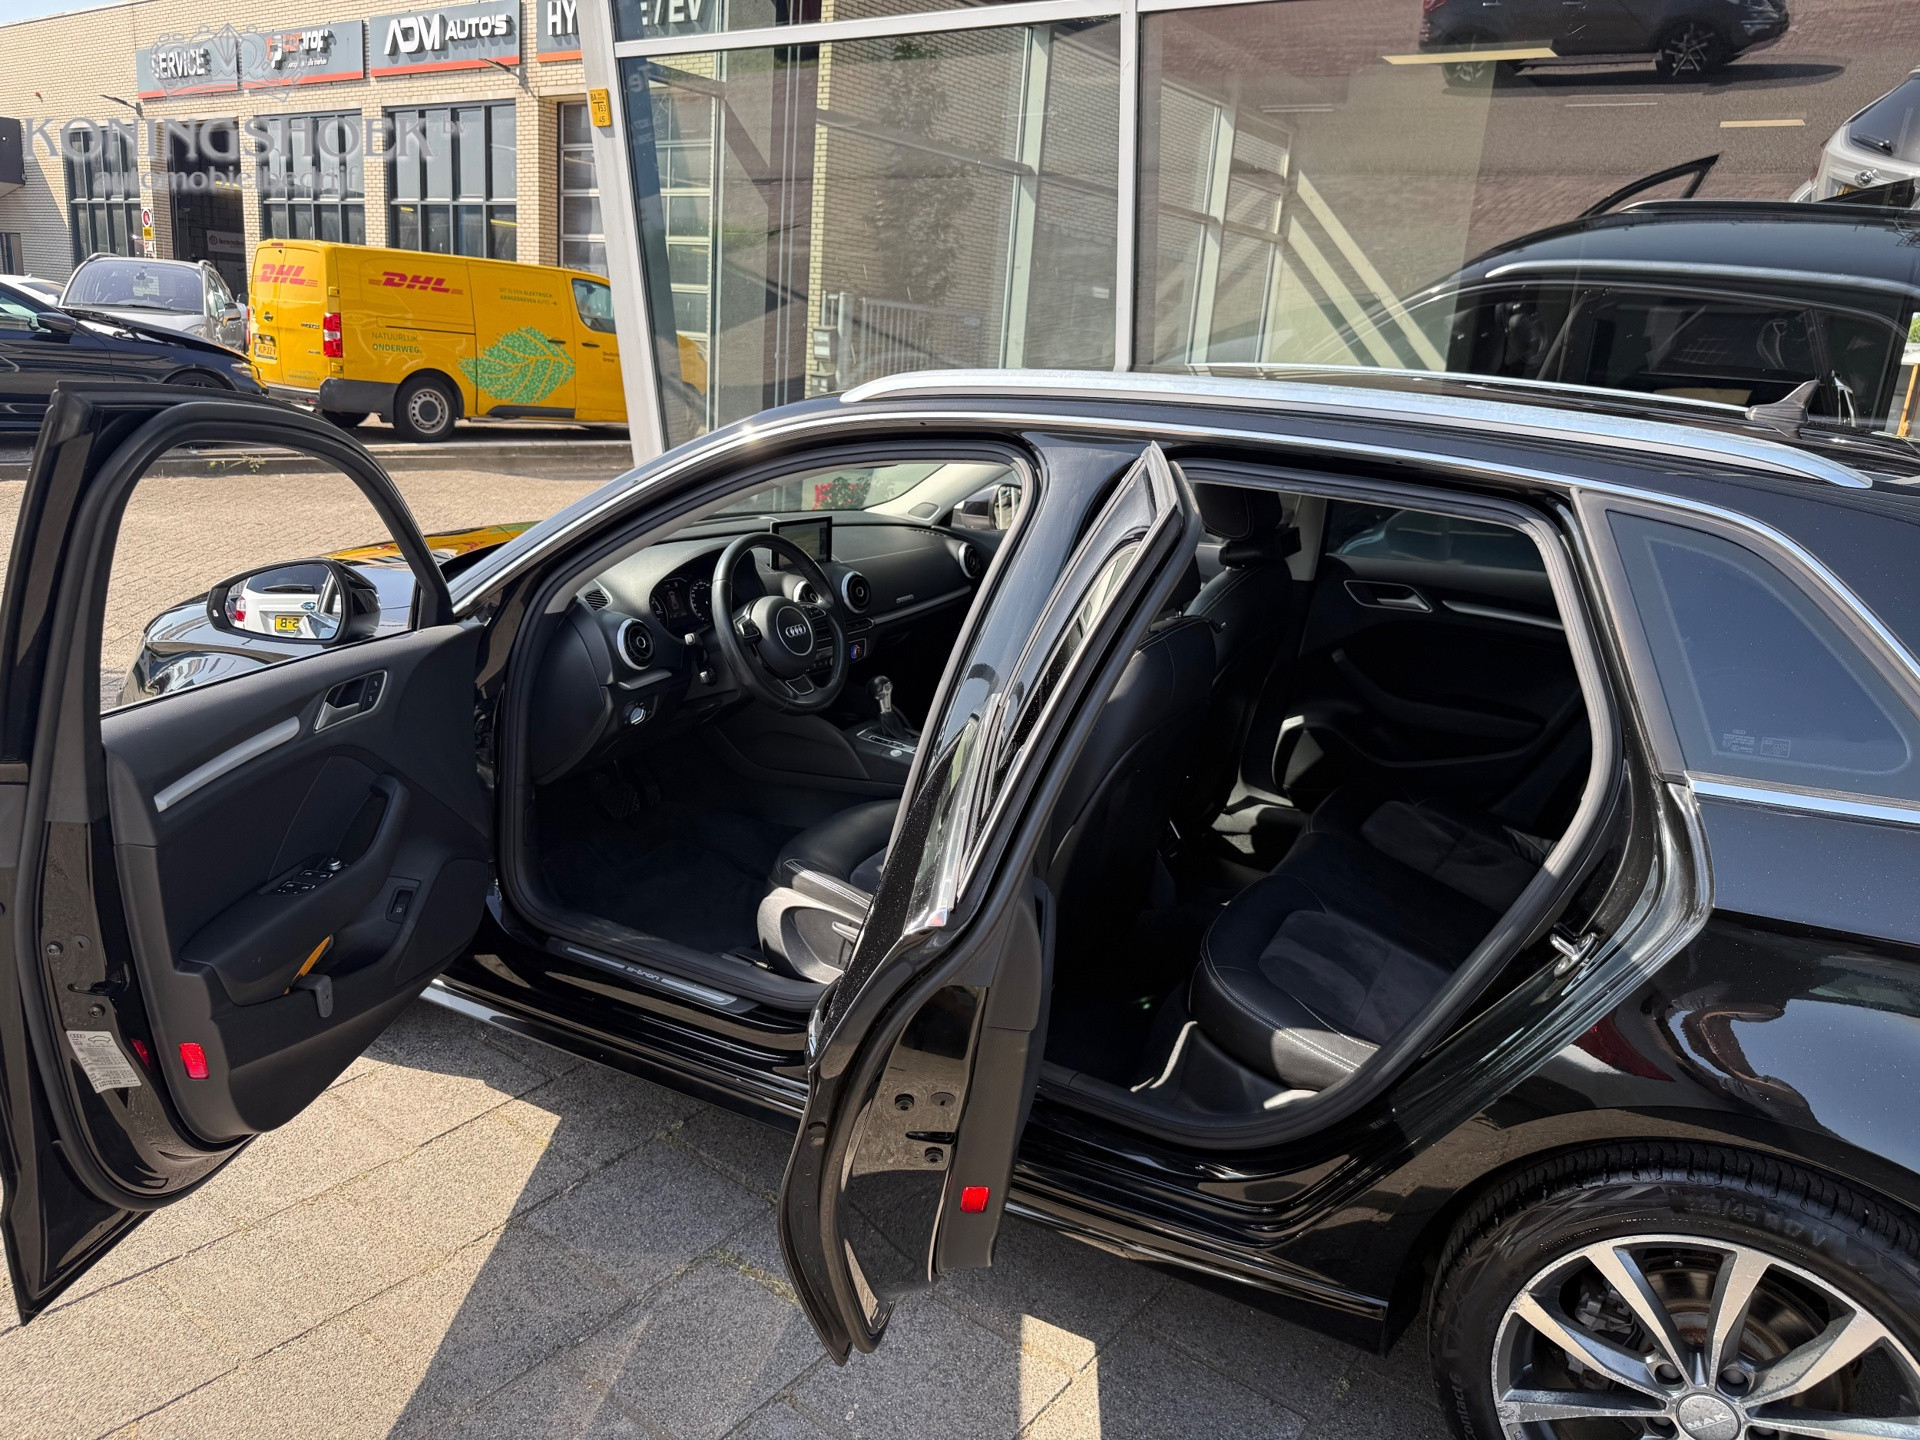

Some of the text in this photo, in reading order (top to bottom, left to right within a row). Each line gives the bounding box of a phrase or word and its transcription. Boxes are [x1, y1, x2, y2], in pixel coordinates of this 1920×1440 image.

[384, 14, 509, 55] ADM AUTO'S
[151, 48, 207, 79] SERVICE
[260, 263, 306, 286] DHL
[382, 271, 450, 293] DHL
[371, 332, 418, 342] NATUURLIJK
[626, 966, 660, 981] e-tron
[1685, 1412, 1730, 1430] MAK
